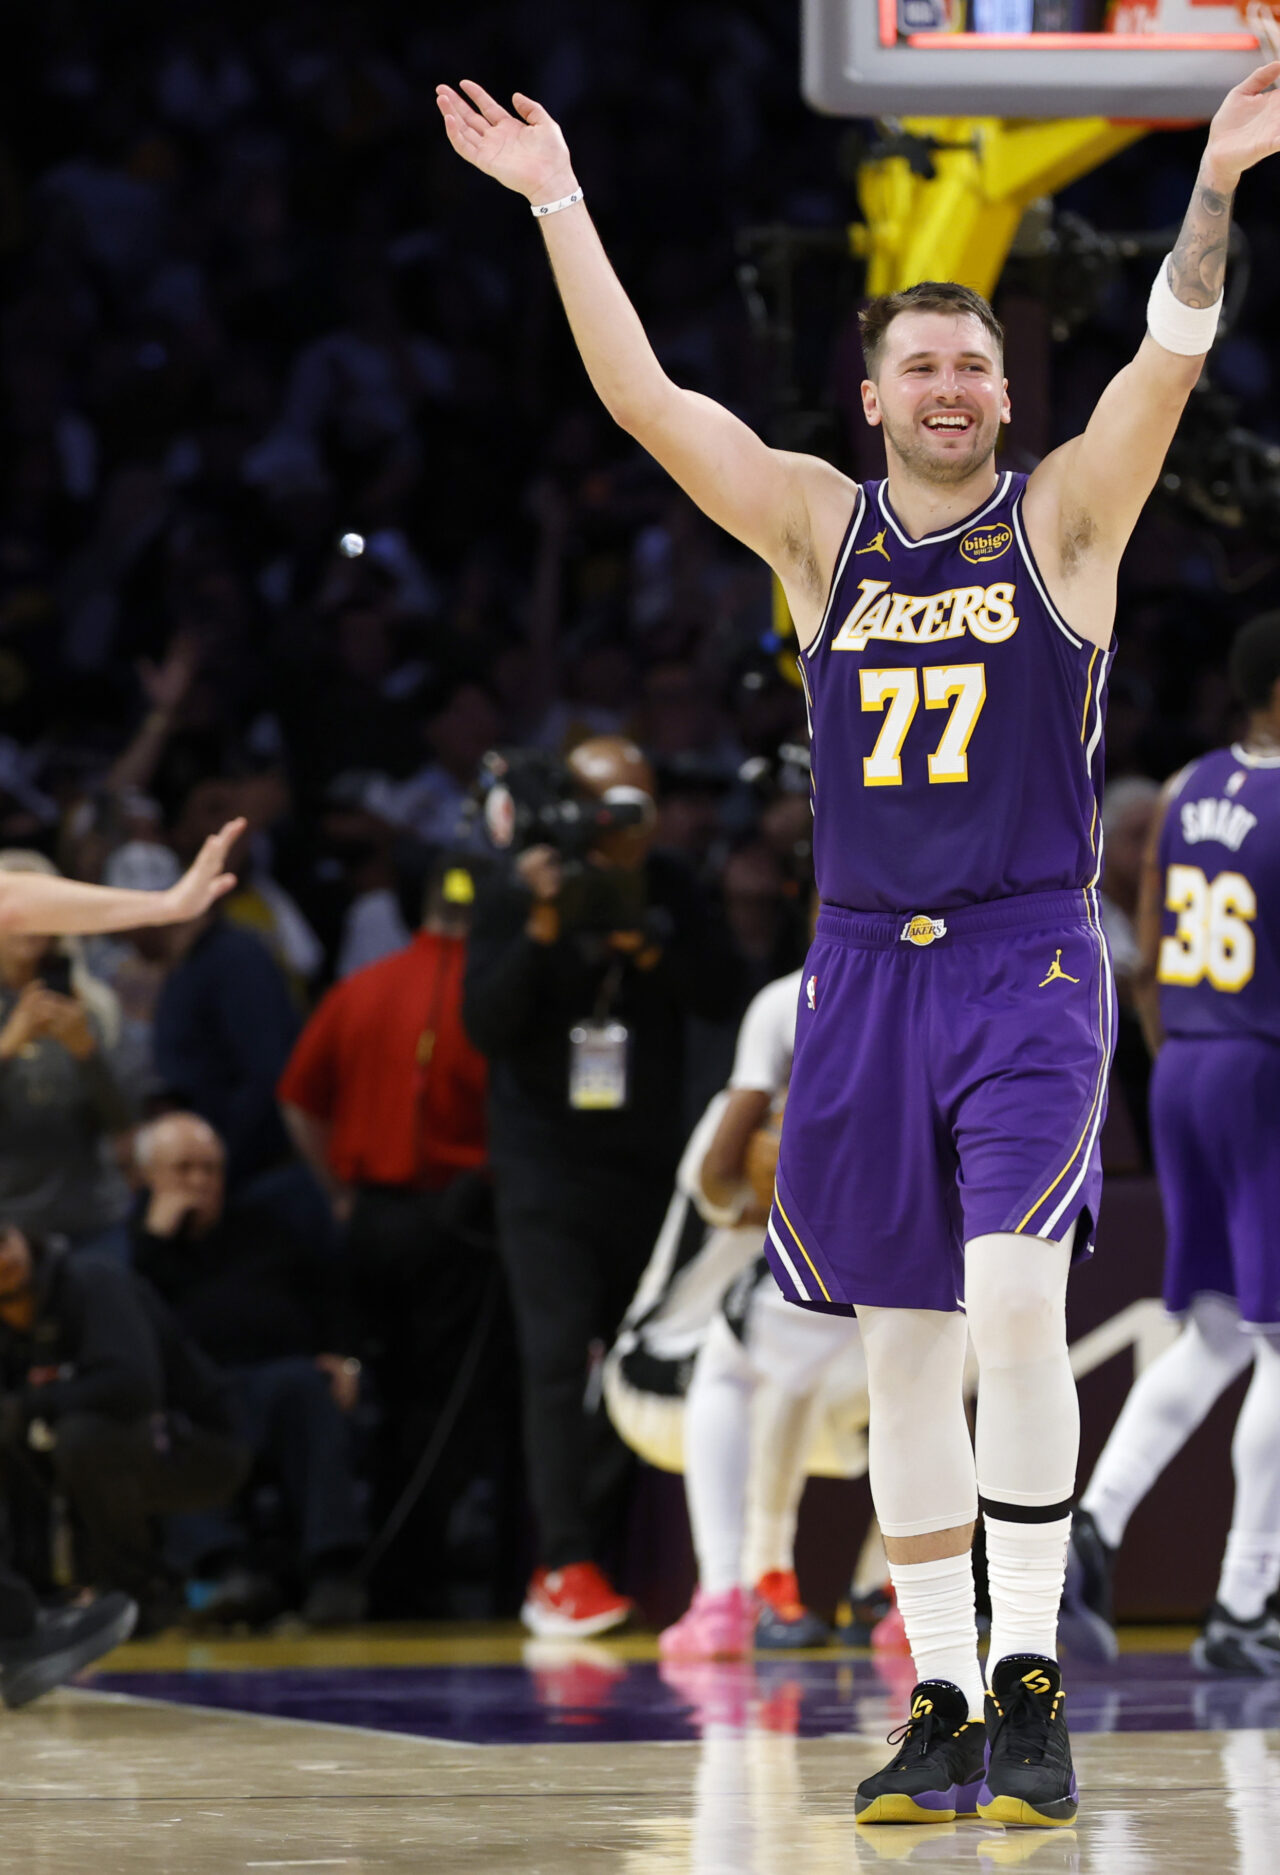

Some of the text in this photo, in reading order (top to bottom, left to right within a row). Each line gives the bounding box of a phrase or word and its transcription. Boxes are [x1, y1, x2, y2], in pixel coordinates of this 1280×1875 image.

[965, 532, 1010, 551] bibigo
[830, 578, 1020, 651] LAKERS
[858, 663, 987, 787] 77
[902, 922, 946, 940] LAKERS
[1156, 863, 1257, 994] 36
